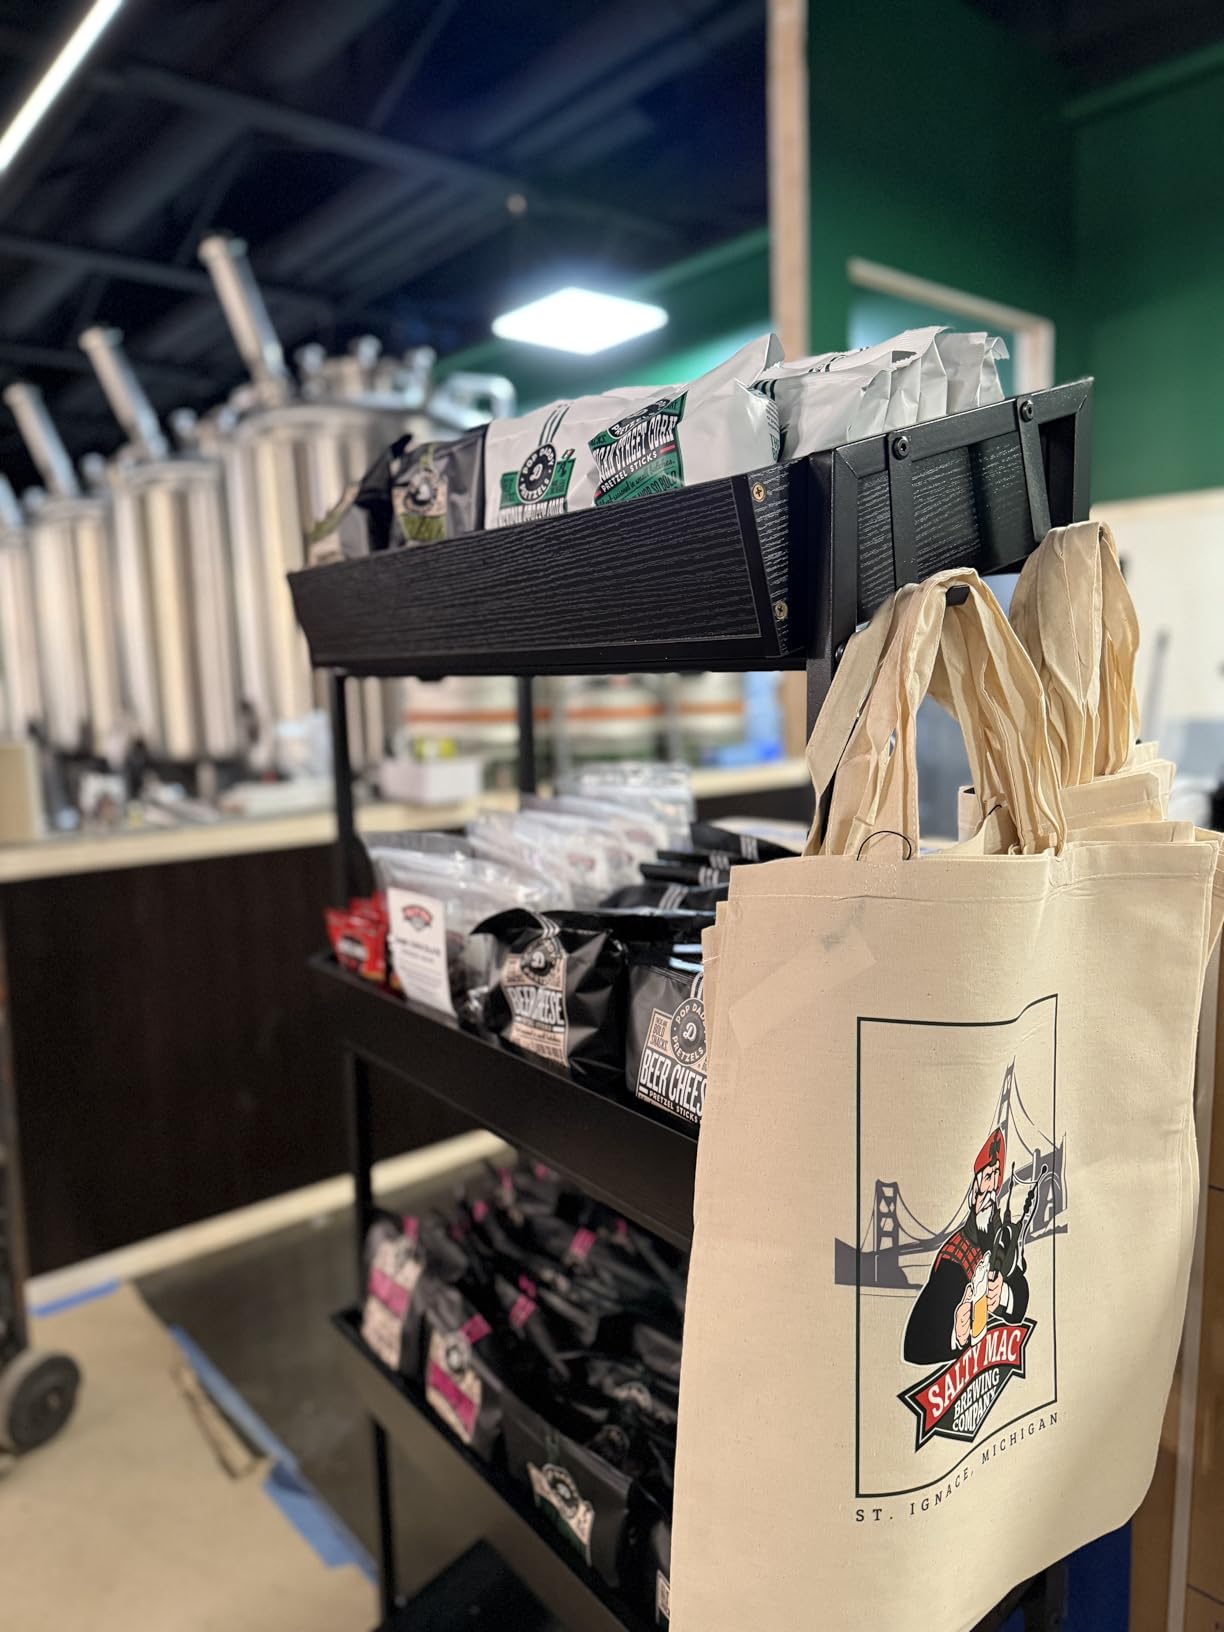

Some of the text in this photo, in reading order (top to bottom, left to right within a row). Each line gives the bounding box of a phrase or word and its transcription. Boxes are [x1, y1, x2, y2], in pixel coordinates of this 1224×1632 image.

[648, 414, 678, 450] CORN
[523, 453, 538, 475] POP
[601, 450, 657, 493] PRETZEL STICKS
[676, 1004, 691, 1025] POP
[671, 1035, 704, 1062] PRETZELS
[640, 1049, 707, 1117] BEER CHEES
[649, 1090, 674, 1110] PRETZEL
[676, 1105, 699, 1123] STICKS
[928, 1329, 1021, 1418] SALTY MAC
[954, 1368, 1000, 1420] BREWING
[952, 1386, 996, 1432] COMPANY
[855, 1412, 1058, 1522] ST. IGNACE, MICHIGAN
